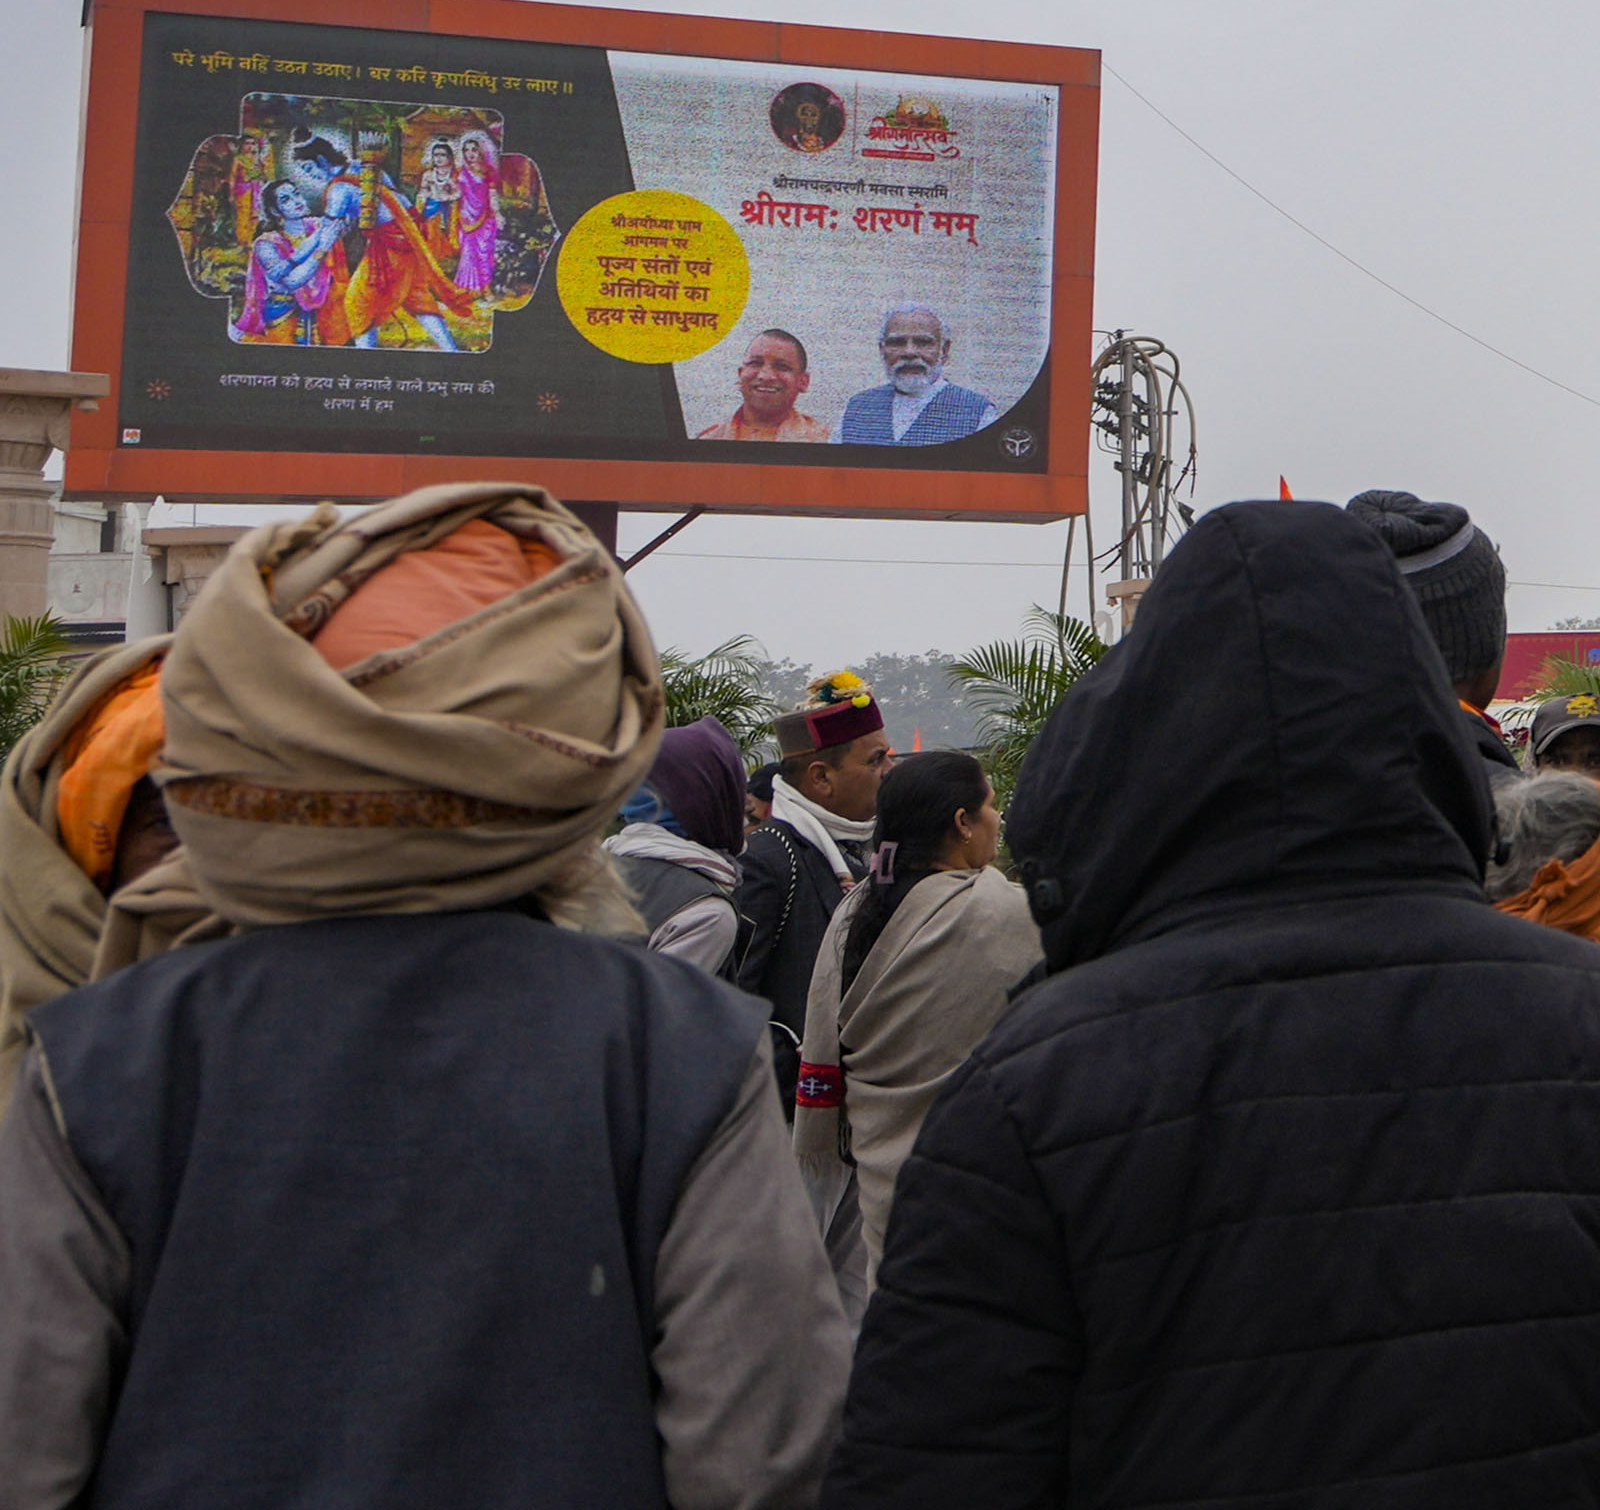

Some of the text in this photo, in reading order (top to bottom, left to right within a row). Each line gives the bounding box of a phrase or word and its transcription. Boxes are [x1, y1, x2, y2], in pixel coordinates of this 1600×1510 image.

[172, 49, 195, 67] परे
[201, 51, 233, 74] भूमि
[274, 60, 307, 75] उठत
[396, 65, 427, 83] करि
[502, 76, 522, 90] उर
[853, 202, 924, 234] शरणं
[672, 237, 689, 250] पर
[597, 254, 713, 278] पूज्य संतों एवं
[599, 277, 710, 301] अतिथियों का
[585, 305, 720, 332] हृदय से साधुवाद
[220, 374, 279, 387] शरणागत
[281, 373, 301, 388] को
[337, 374, 352, 389] से
[355, 376, 393, 391] लगाने
[397, 377, 423, 392] वाले
[450, 382, 475, 394] राम
[478, 380, 495, 395] की
[323, 398, 356, 410] शरण
[360, 395, 372, 410] में
